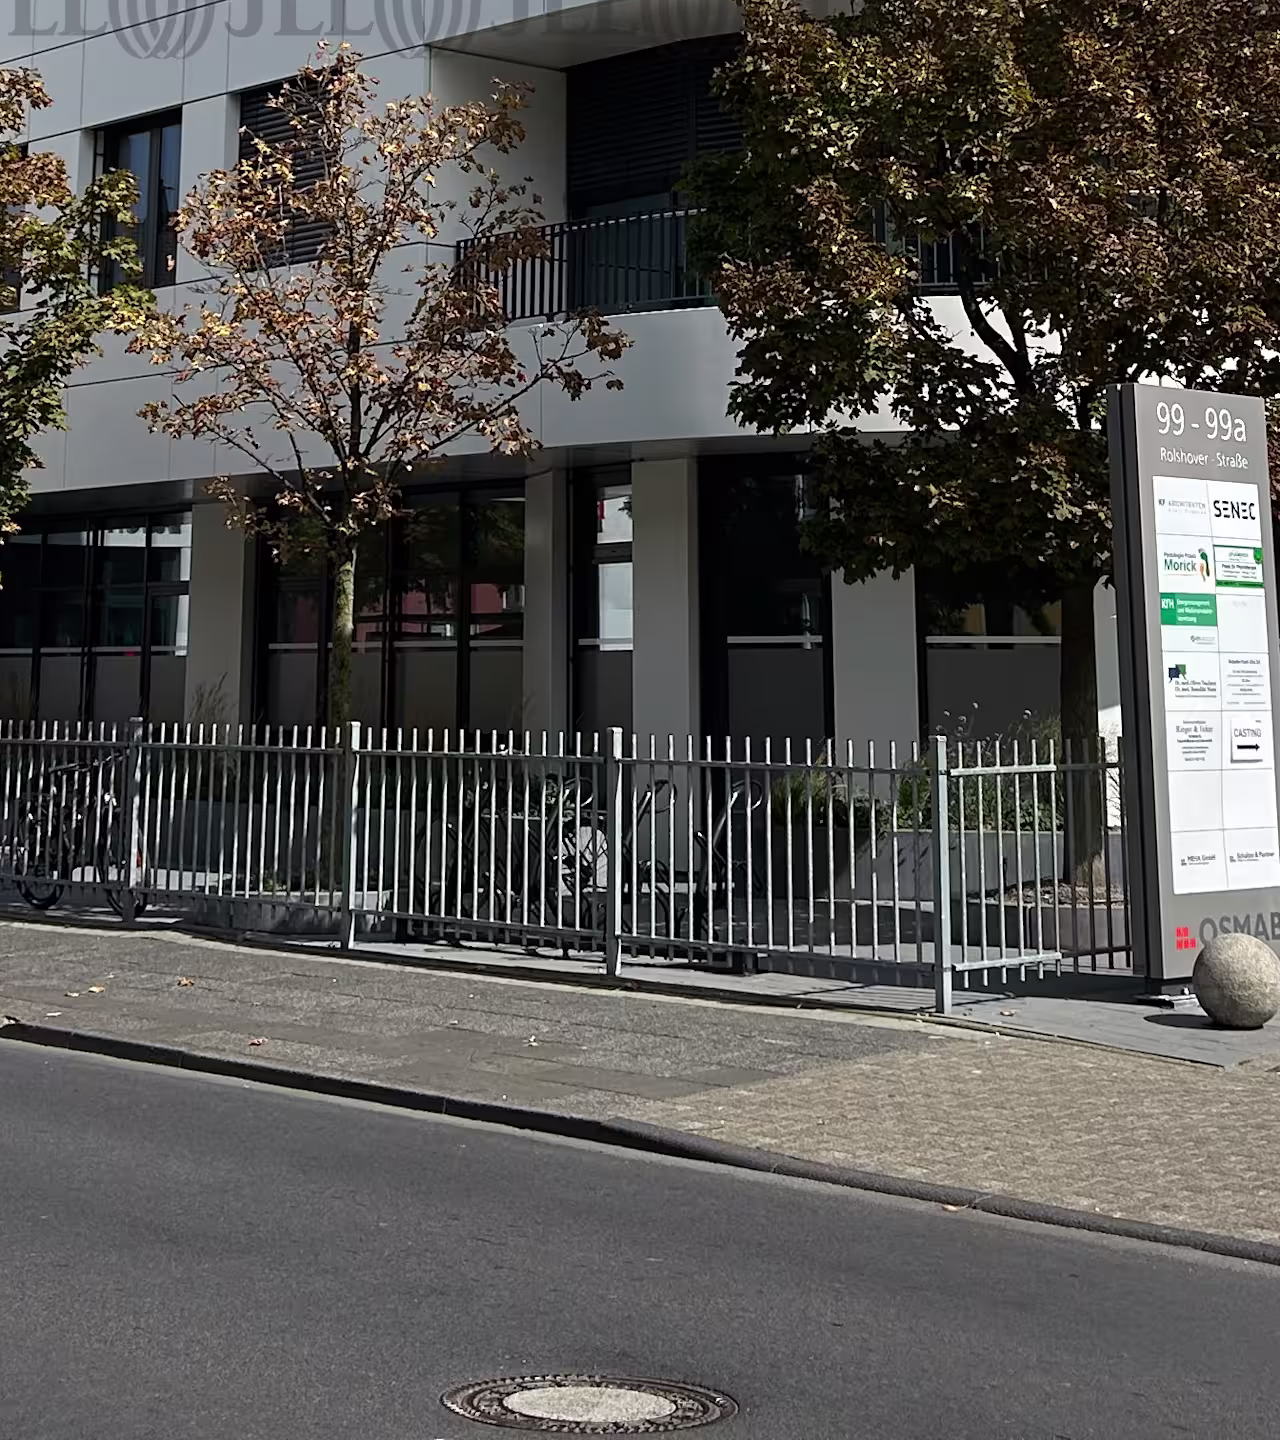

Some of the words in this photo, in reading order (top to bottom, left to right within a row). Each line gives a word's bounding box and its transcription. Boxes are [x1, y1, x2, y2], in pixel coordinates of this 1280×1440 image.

[1156, 401, 1185, 436] 99
[1205, 407, 1247, 442] 99a
[1160, 447, 1209, 466] Rolshover
[1216, 452, 1249, 469] Straße
[1213, 500, 1256, 520] SENEC
[1164, 558, 1197, 572] Morick
[1234, 728, 1262, 738] CASTING
